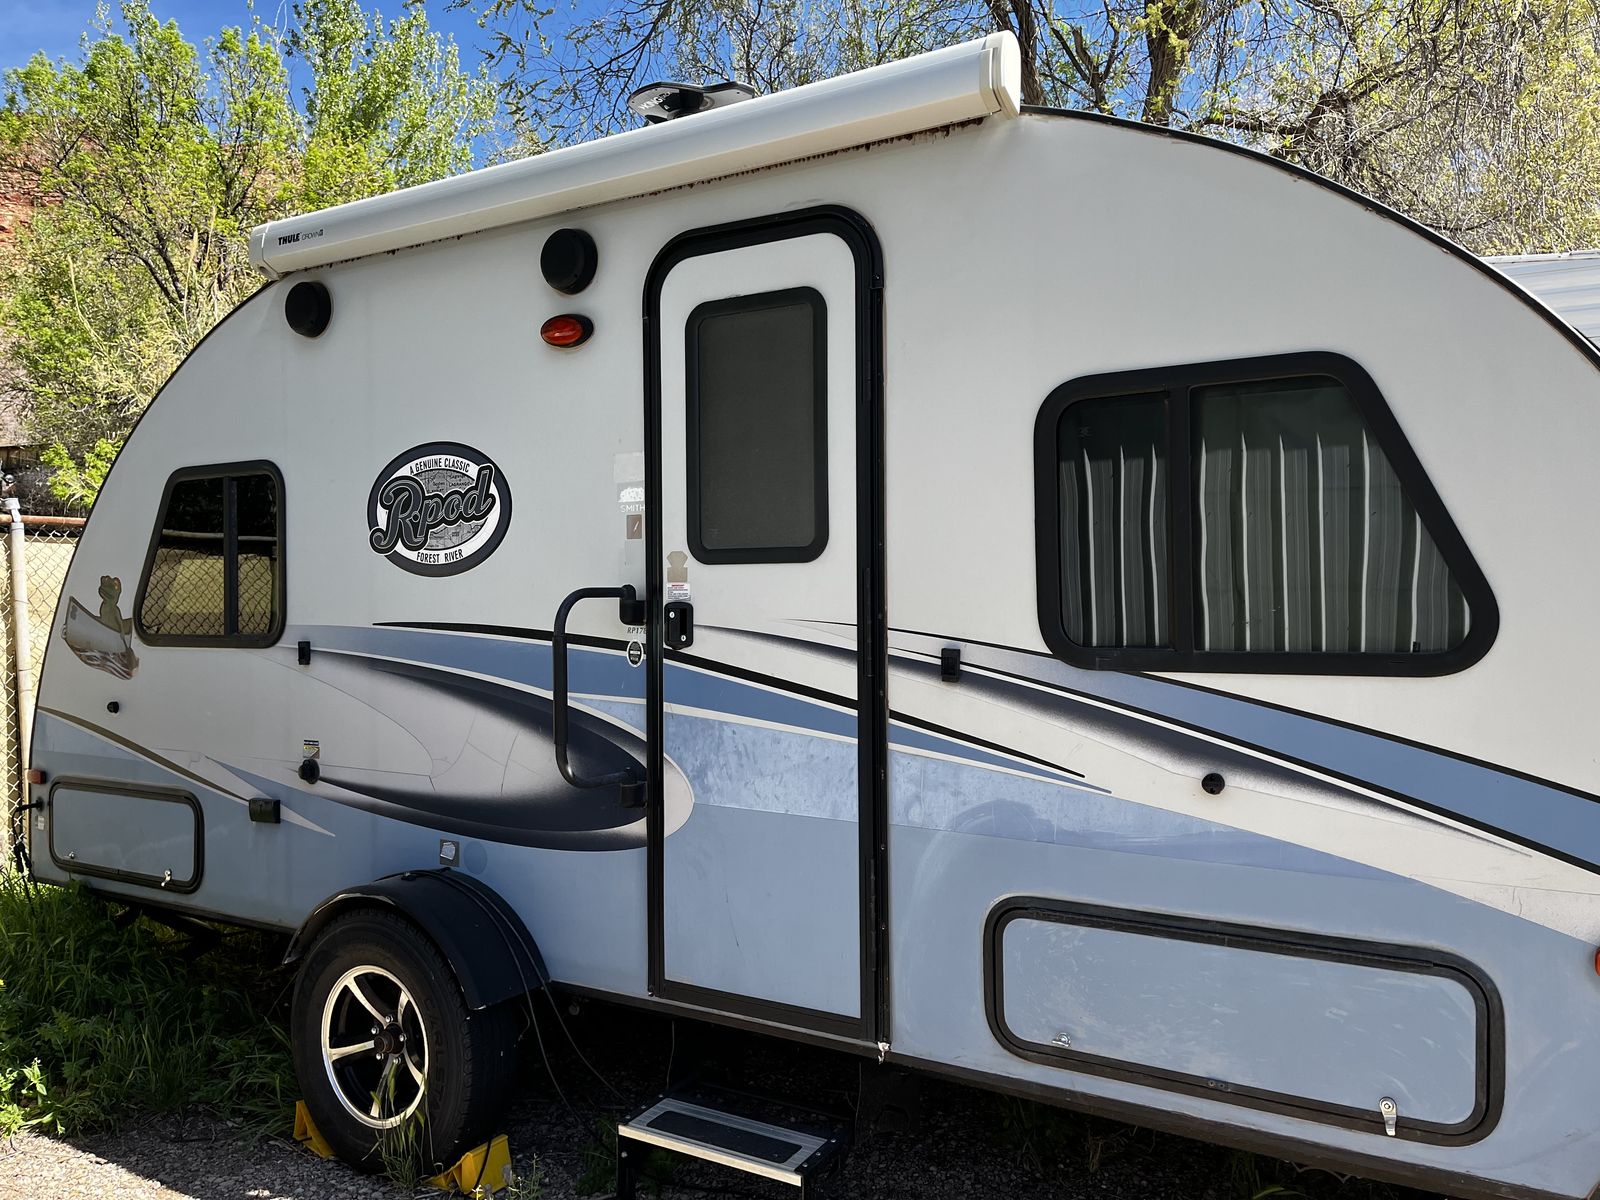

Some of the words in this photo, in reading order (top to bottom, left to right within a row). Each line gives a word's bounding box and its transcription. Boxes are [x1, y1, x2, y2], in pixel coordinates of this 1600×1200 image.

[278, 233, 300, 246] THULE
[409, 465, 415, 476] A
[416, 458, 442, 472] GENUINE
[444, 458, 470, 472] CLASSIC
[417, 552, 440, 563] FOREST
[445, 549, 464, 563] RIVER
